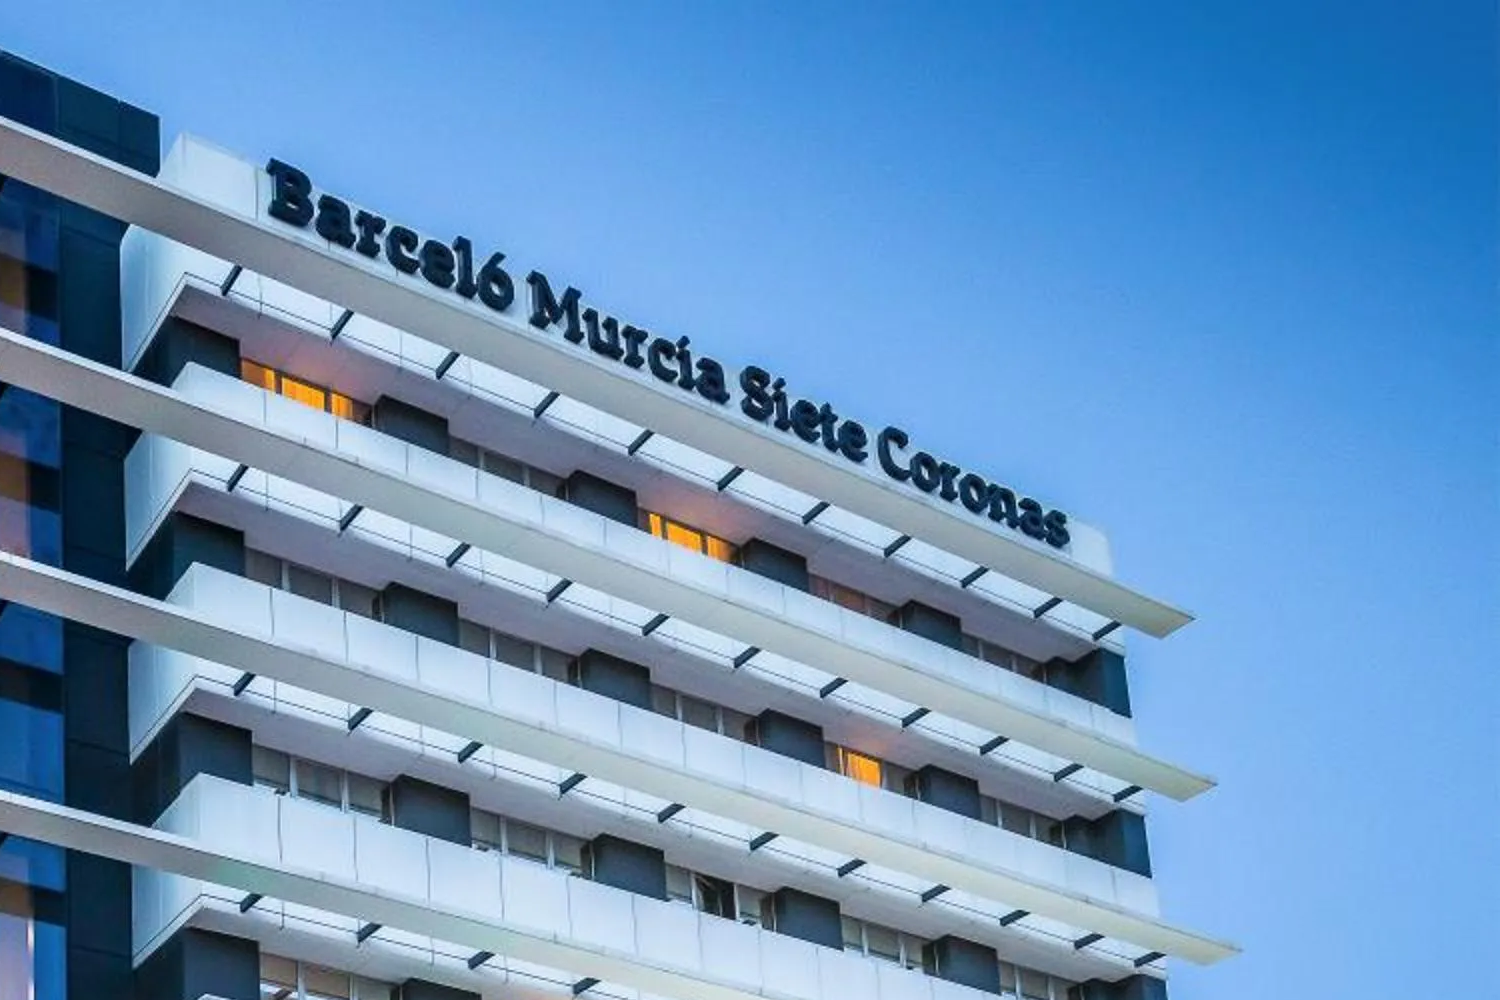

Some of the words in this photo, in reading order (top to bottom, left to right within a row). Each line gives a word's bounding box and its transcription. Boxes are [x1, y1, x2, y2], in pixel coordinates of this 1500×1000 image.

[266, 158, 514, 311] Barceló
[526, 270, 730, 404] Murcia
[739, 365, 868, 463] Siete
[877, 426, 1071, 548] Coronas
